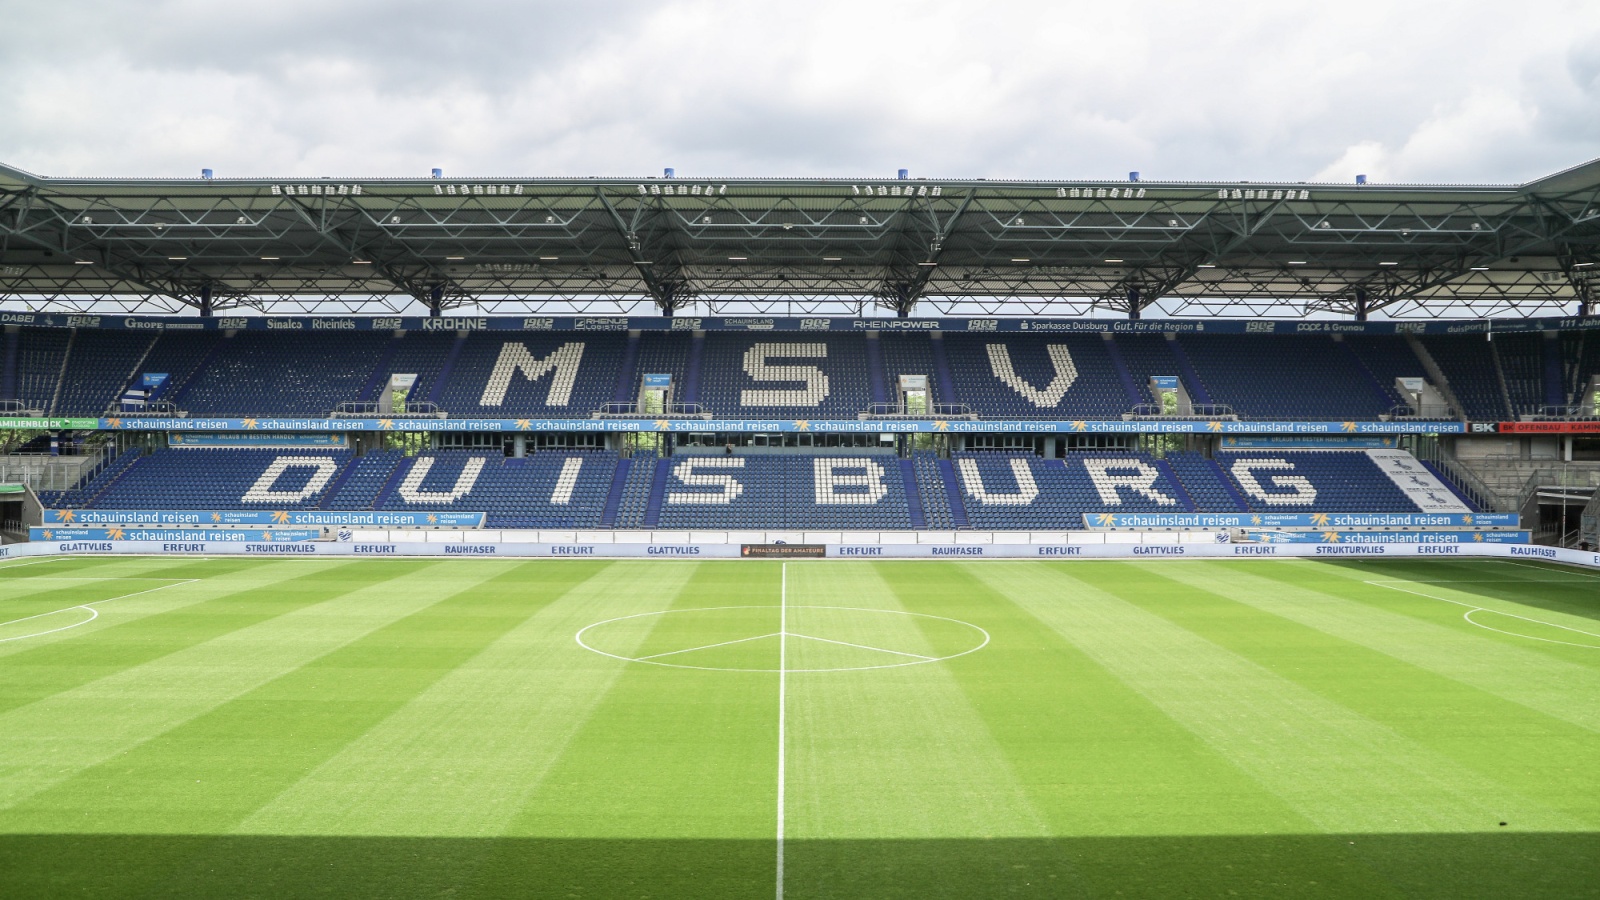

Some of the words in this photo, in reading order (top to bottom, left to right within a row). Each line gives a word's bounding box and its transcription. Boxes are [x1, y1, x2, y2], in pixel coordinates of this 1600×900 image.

[2, 314, 35, 323] DABEI
[67, 316, 101, 325] 1902
[218, 318, 248, 326] 1902
[372, 318, 402, 326] 1902
[523, 318, 554, 326] 1902
[672, 318, 702, 326] 1902
[800, 318, 831, 327] 1902
[968, 319, 998, 327] 1902
[1560, 319, 1576, 327] 111
[267, 319, 302, 329] Sinalco
[312, 318, 355, 329] Rheinfels
[422, 318, 487, 329] KROHNE
[1031, 321, 1071, 331] Sparkasse
[1073, 321, 1108, 331] Duisburg
[1114, 322, 1133, 331] Gut.
[1134, 322, 1148, 330] Für
[1149, 322, 1162, 330] die
[1164, 322, 1193, 332] Region
[1246, 321, 1275, 329] 1902
[1323, 323, 1330, 331] &
[1332, 323, 1365, 332] Grunau
[1447, 323, 1482, 333] duisport
[126, 419, 193, 429] schauinsland
[196, 420, 228, 429] reisen
[262, 420, 329, 430] schauinsland
[332, 420, 364, 430] reisen
[398, 420, 466, 430] schauinsland
[469, 420, 501, 430] reisen
[536, 420, 604, 430] schauinsland
[607, 421, 640, 430] reisen
[675, 420, 744, 431] schauinsland
[747, 421, 779, 431] reisen
[814, 421, 884, 431] schauinsland
[886, 422, 918, 431] reisen
[953, 421, 1021, 431] schauinsland
[1024, 422, 1057, 431] reisen
[1091, 421, 1159, 432] schauinsland
[1161, 422, 1193, 432] reisen
[1227, 422, 1294, 432] schauinsland
[1296, 423, 1328, 432] reisen
[1361, 422, 1427, 432] schauinsland
[1428, 423, 1459, 432] reisen
[1472, 423, 1496, 432] BK
[80, 511, 159, 524] schauinsland
[162, 512, 199, 524] reisen
[295, 511, 374, 525] schauinsland
[377, 513, 414, 525] reisen
[1121, 514, 1200, 527] schauinsland
[1202, 516, 1239, 527] reisen
[1334, 513, 1411, 526] schauinsland
[1414, 514, 1451, 526] reisen
[130, 529, 206, 541] schauinsland
[209, 530, 245, 541] reisen
[1344, 532, 1419, 543] schauinsland
[1421, 533, 1458, 543] reisen
[59, 543, 113, 552] GLATTVLIES
[163, 543, 206, 552] ERFURT
[245, 544, 316, 553] STRUKTURVLIES
[354, 545, 397, 554] ERFURT
[445, 545, 496, 554] RAUHFASER
[551, 546, 595, 554] ERFURT
[647, 546, 700, 554] GLATTVLIES
[839, 547, 883, 555] ERFURT
[932, 547, 983, 555] RAUHFASER
[1038, 547, 1082, 555] ERFURT
[1133, 546, 1184, 554] GLATTVLIES
[1235, 546, 1276, 554] ERFURT
[1316, 546, 1385, 554] STRUKTURVLIES
[1510, 546, 1557, 557] RAUHFASER
